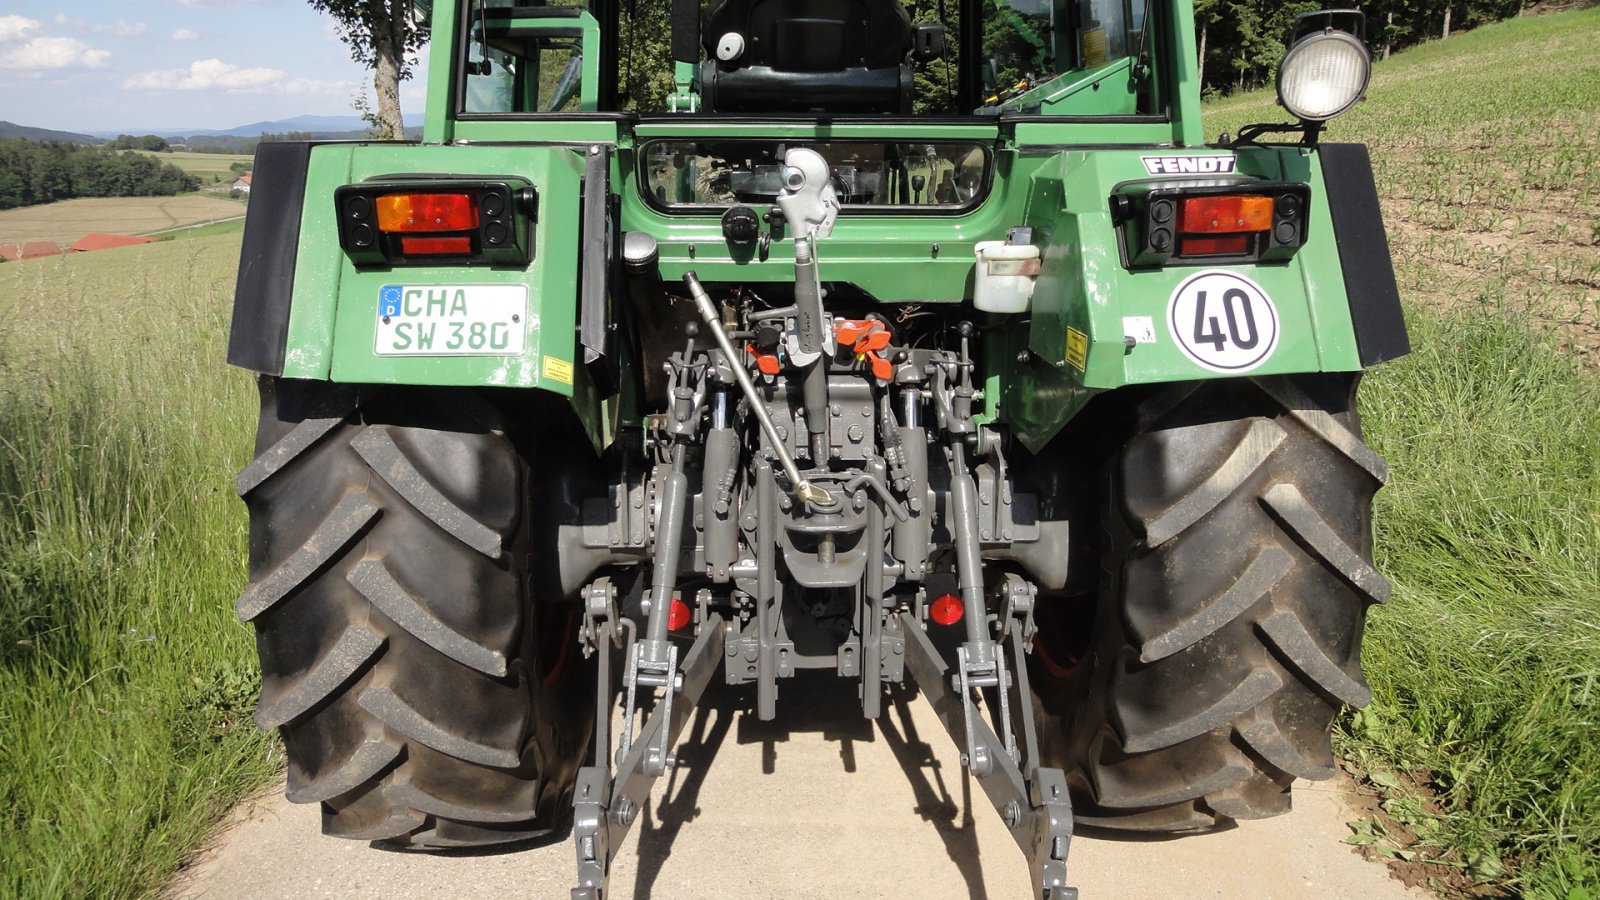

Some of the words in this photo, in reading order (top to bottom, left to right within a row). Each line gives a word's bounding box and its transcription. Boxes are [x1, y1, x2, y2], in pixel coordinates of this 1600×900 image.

[1143, 156, 1235, 173] FENDT
[386, 305, 396, 316] D
[404, 289, 468, 317] CHA
[1193, 287, 1259, 352] 40
[392, 322, 436, 350] SW
[445, 322, 509, 350] 380
